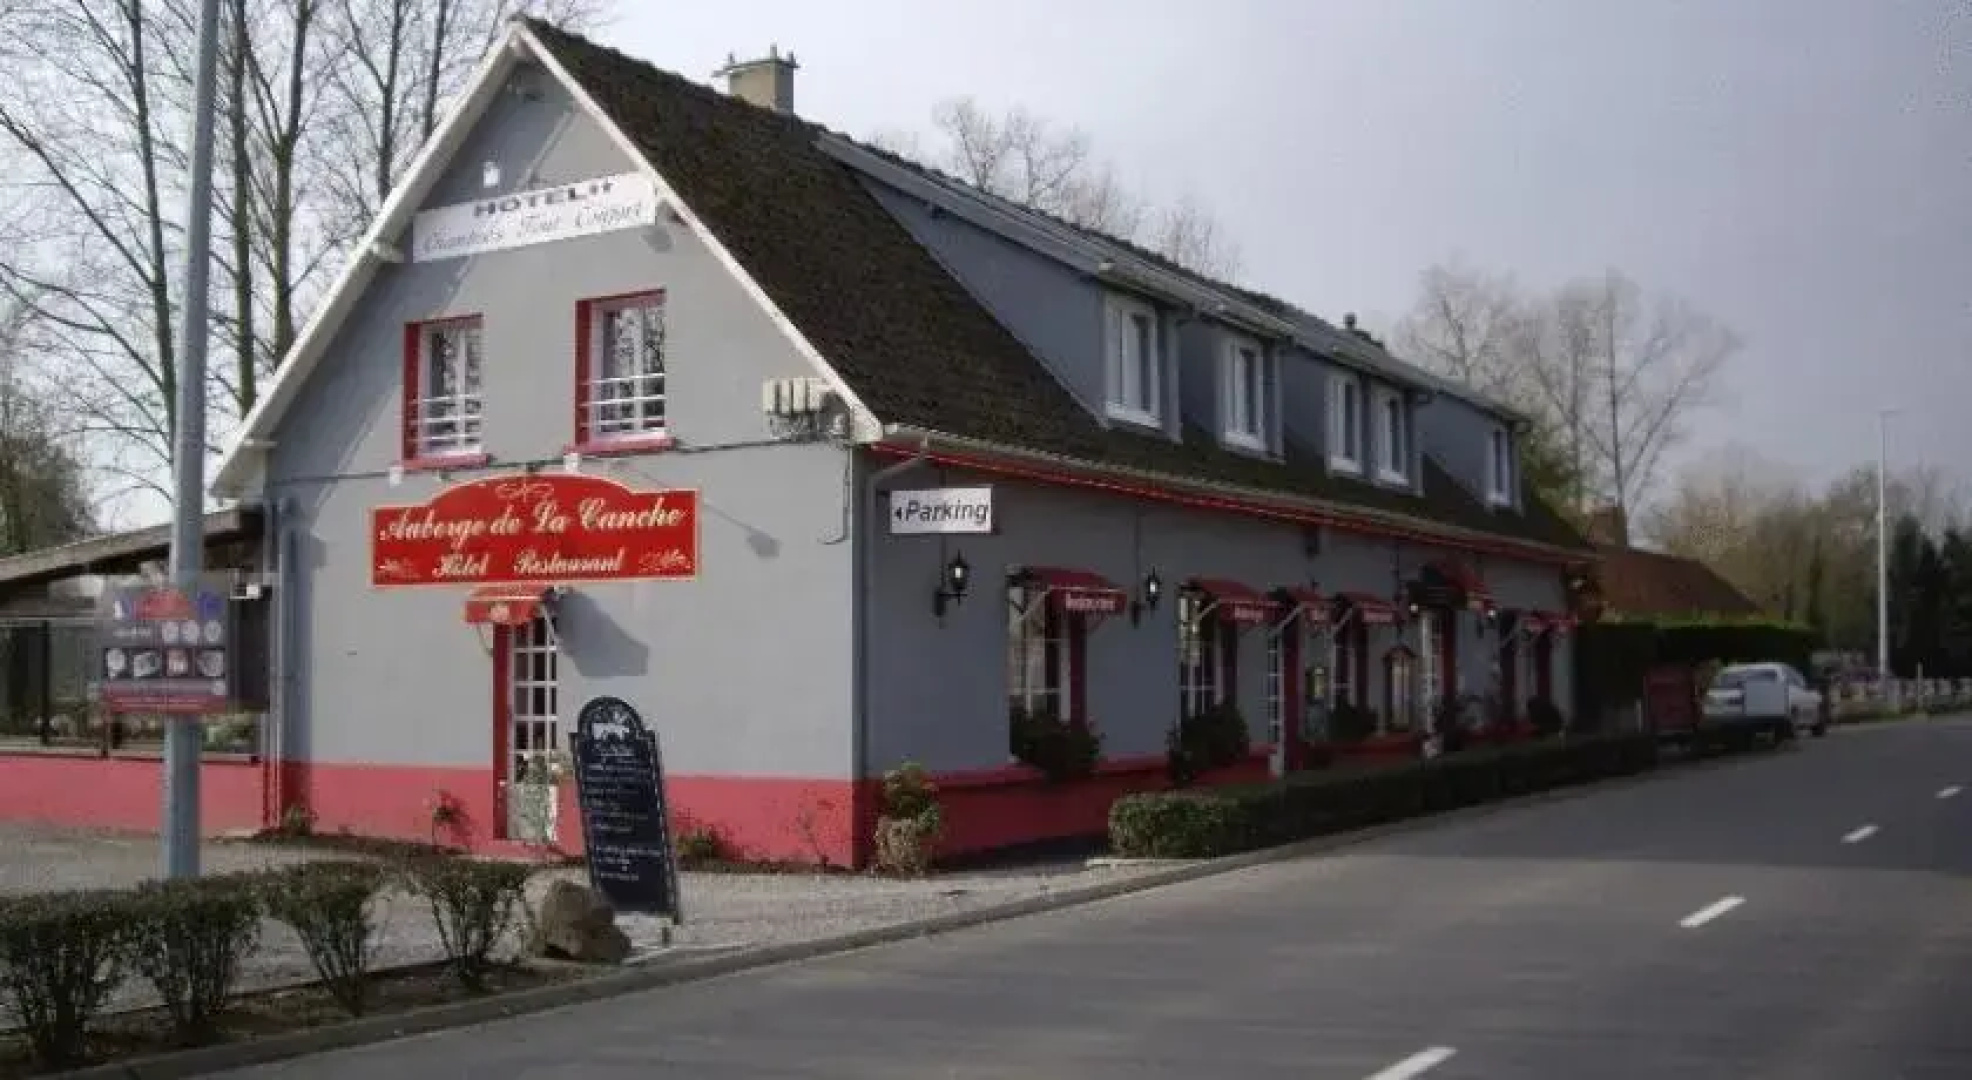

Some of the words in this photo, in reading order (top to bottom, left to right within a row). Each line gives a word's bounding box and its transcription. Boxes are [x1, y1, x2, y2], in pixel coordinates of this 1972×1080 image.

[379, 509, 486, 552] Auberge
[490, 506, 521, 536] de
[532, 498, 569, 533] La
[577, 496, 686, 531] Canche
[905, 499, 989, 527] Parking
[513, 547, 625, 575] Restaurant
